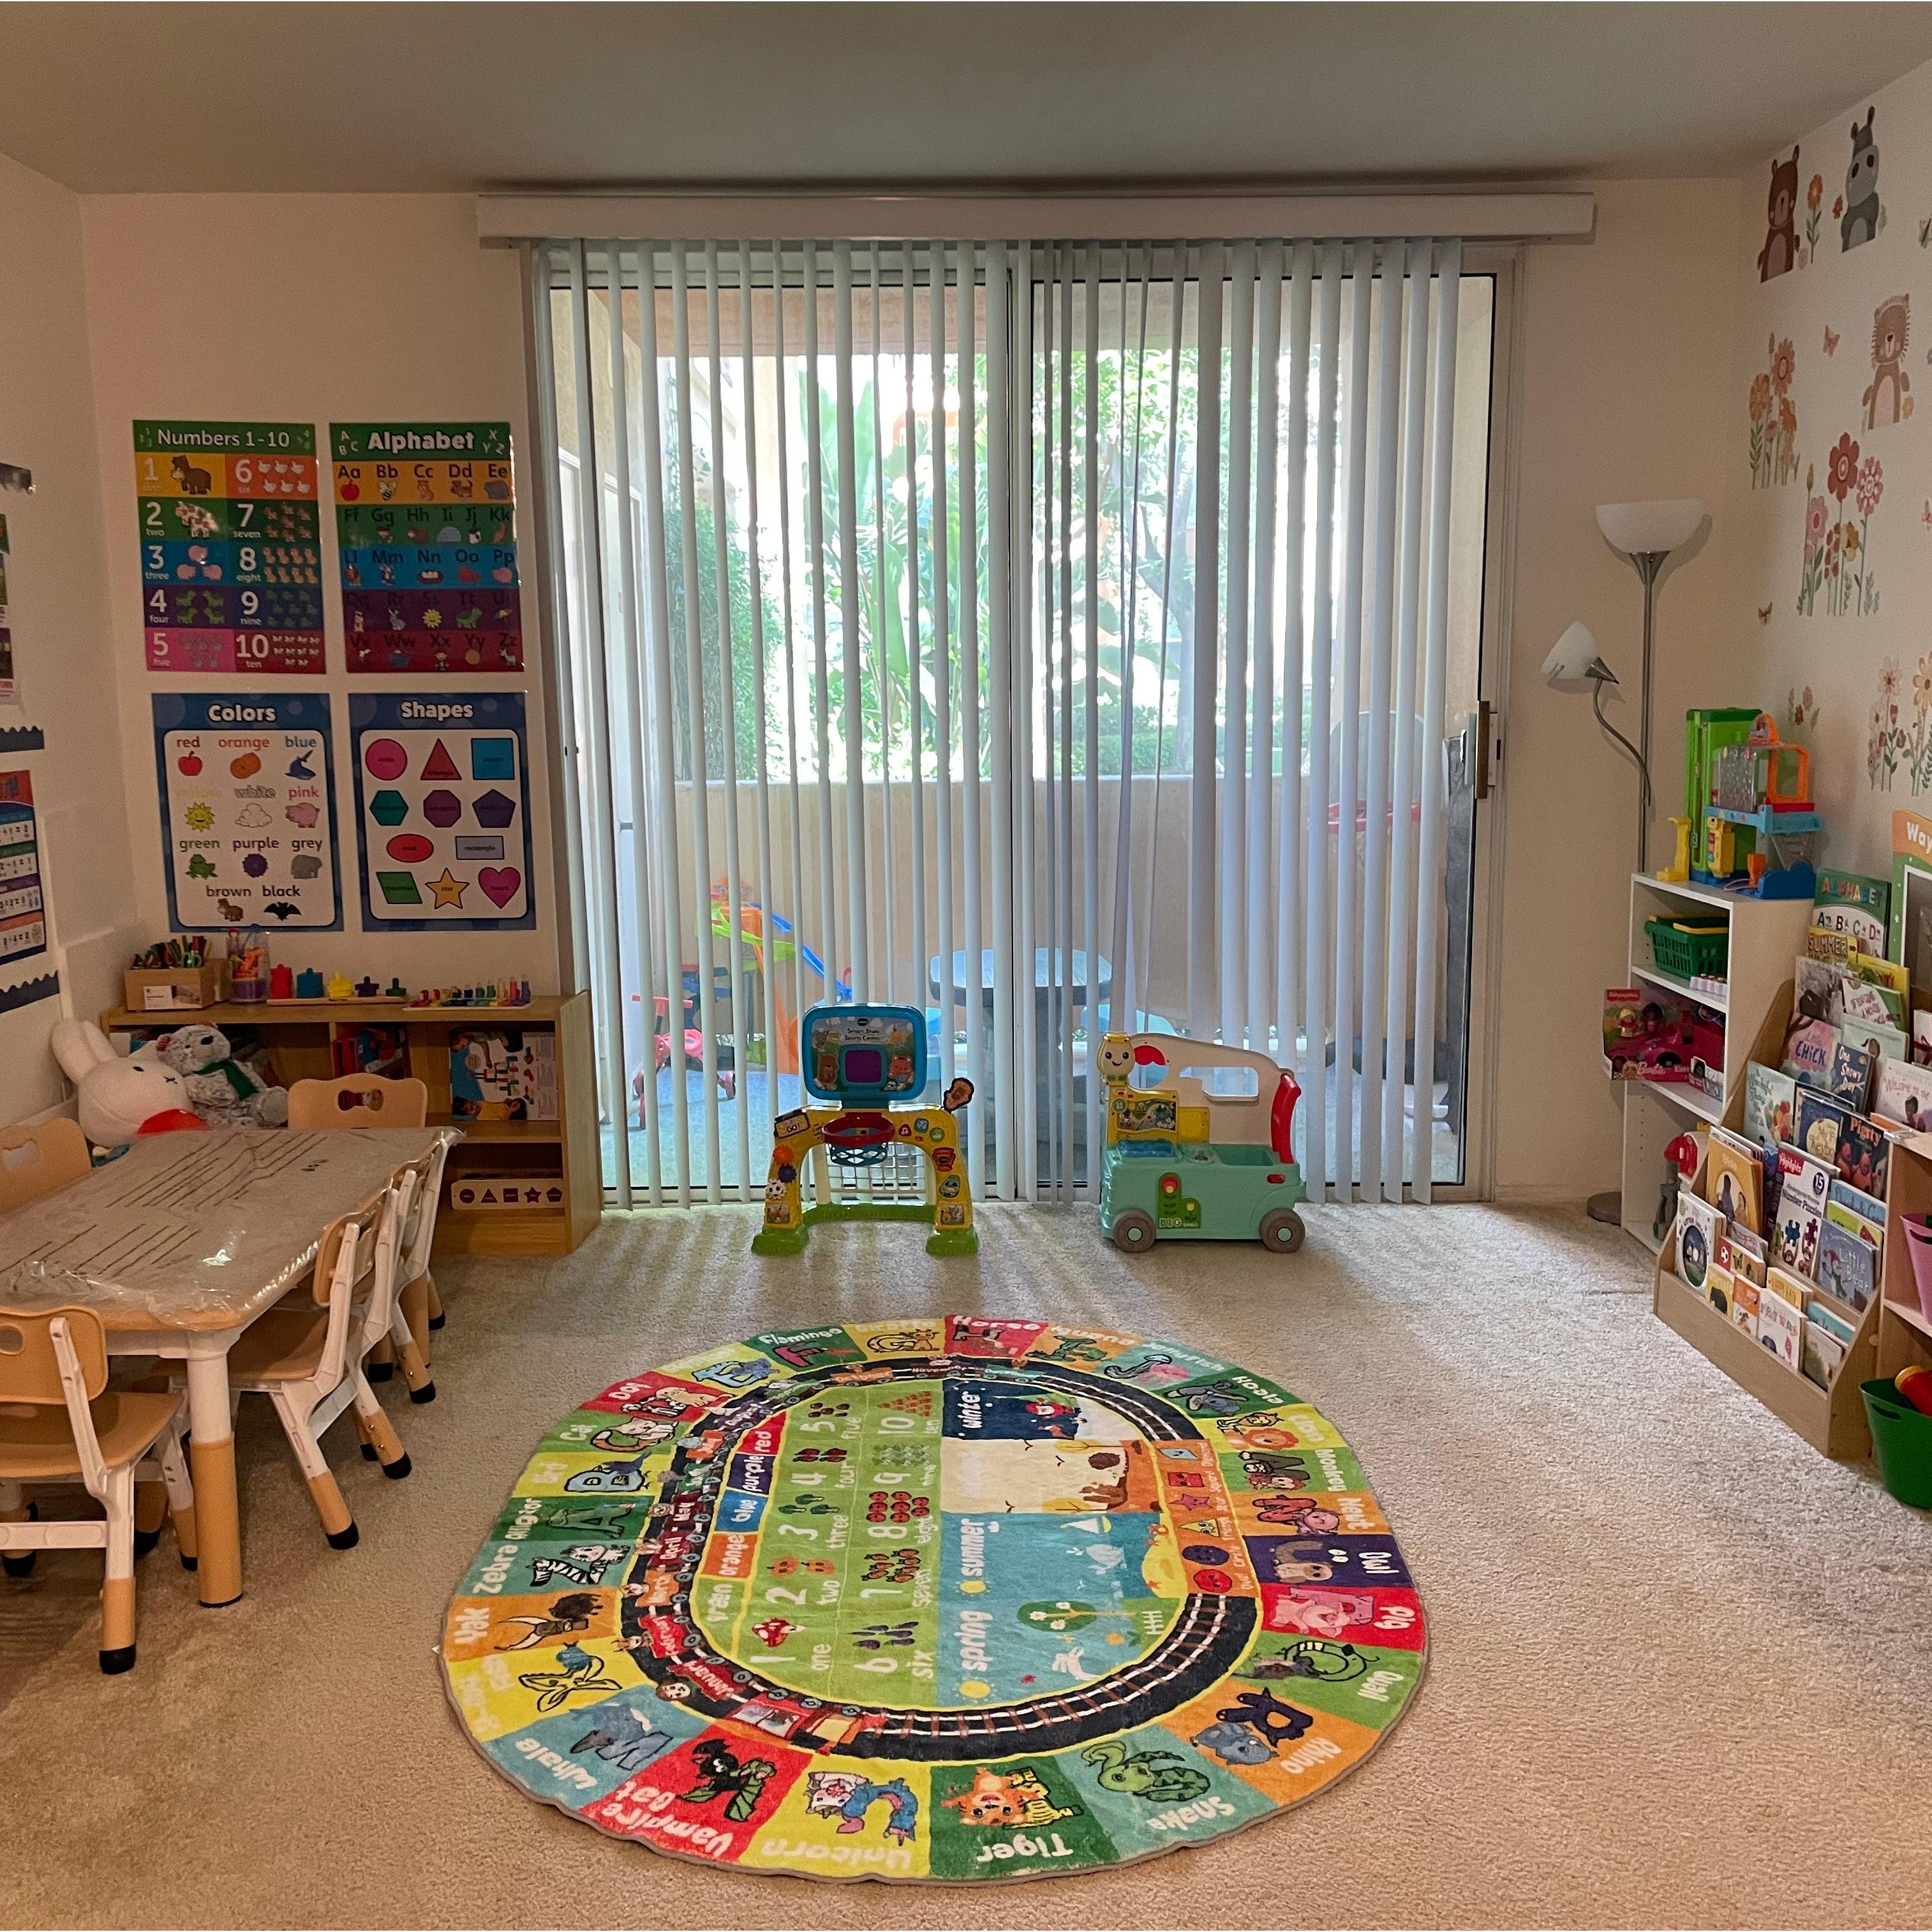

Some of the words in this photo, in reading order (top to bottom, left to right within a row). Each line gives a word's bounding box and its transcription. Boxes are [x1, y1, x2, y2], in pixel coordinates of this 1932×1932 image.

[158, 429, 240, 447] Numbers
[246, 431, 290, 447] 1-10
[368, 430, 474, 454] Alphabet
[144, 458, 158, 481] 1
[235, 459, 252, 483] 6
[338, 465, 360, 479] Aa
[376, 464, 398, 478] Bb
[414, 464, 433, 478] Cc
[449, 463, 472, 478] Dd
[489, 464, 507, 477] Ee
[146, 502, 163, 526] 2
[237, 503, 255, 527] 7
[371, 509, 394, 526] Gg
[407, 509, 429, 522] Hh
[146, 528, 165, 537] two
[233, 530, 261, 539] seven
[149, 546, 163, 569] 3
[239, 547, 256, 571] 8
[373, 550, 403, 564] Mm
[418, 551, 441, 563] Nn
[456, 549, 479, 563] Oo
[494, 549, 514, 567] Pp
[145, 572, 169, 580] three
[236, 573, 261, 583] eight
[149, 589, 167, 613] 4
[241, 591, 259, 616] 9
[150, 615, 168, 623] four
[241, 617, 262, 626] nine
[153, 632, 168, 656] 5
[236, 634, 269, 658] 10
[246, 660, 262, 668] ten
[208, 704, 276, 722] Colors
[400, 701, 474, 721] Shapes
[177, 736, 200, 748] red
[218, 737, 270, 751] orange
[285, 736, 317, 747] blue
[234, 785, 276, 798] white
[288, 787, 319, 800] pink
[179, 840, 220, 852] green
[233, 837, 279, 852] purple
[292, 839, 323, 852] grey
[206, 886, 251, 897] brown
[262, 886, 301, 897] black
[1808, 936, 1847, 955] SUMMER
[1816, 1175, 1824, 1187] 15
[1159, 1217, 1182, 1228] DIG
[1839, 1247, 1865, 1273] Little
[1847, 1267, 1869, 1289] Bear
[953, 1315, 1041, 1331] Horse
[759, 1328, 842, 1344] Flamingo
[878, 1416, 915, 1435] 10
[755, 1431, 771, 1453] red
[743, 1455, 764, 1492] purple
[791, 1472, 827, 1485] 4
[835, 1461, 856, 1488] four
[1315, 1448, 1347, 1492] Monkey
[731, 1499, 758, 1522] blue
[1338, 1498, 1376, 1531] Newt
[778, 1524, 819, 1540] 3
[826, 1514, 849, 1549] three
[868, 1526, 908, 1540] 8
[719, 1534, 748, 1576] orange
[960, 1518, 985, 1577] summer
[473, 1543, 519, 1594] Zebra
[1358, 1551, 1399, 1574] Owl
[766, 1587, 807, 1605] 2
[816, 1580, 842, 1605] two
[1373, 1606, 1416, 1630] Pig
[953, 1610, 993, 1671] spring
[812, 1643, 831, 1671] one
[854, 1658, 898, 1673] 6
[910, 1649, 936, 1679] six
[1356, 1670, 1404, 1702] Quail
[515, 1737, 598, 1790] Whale
[616, 1780, 672, 1813] Bat
[1147, 1795, 1236, 1831] Snake
[602, 1802, 734, 1859] Vampire
[762, 1838, 912, 1871] Unicorn
[976, 1832, 1074, 1863] Tiger
